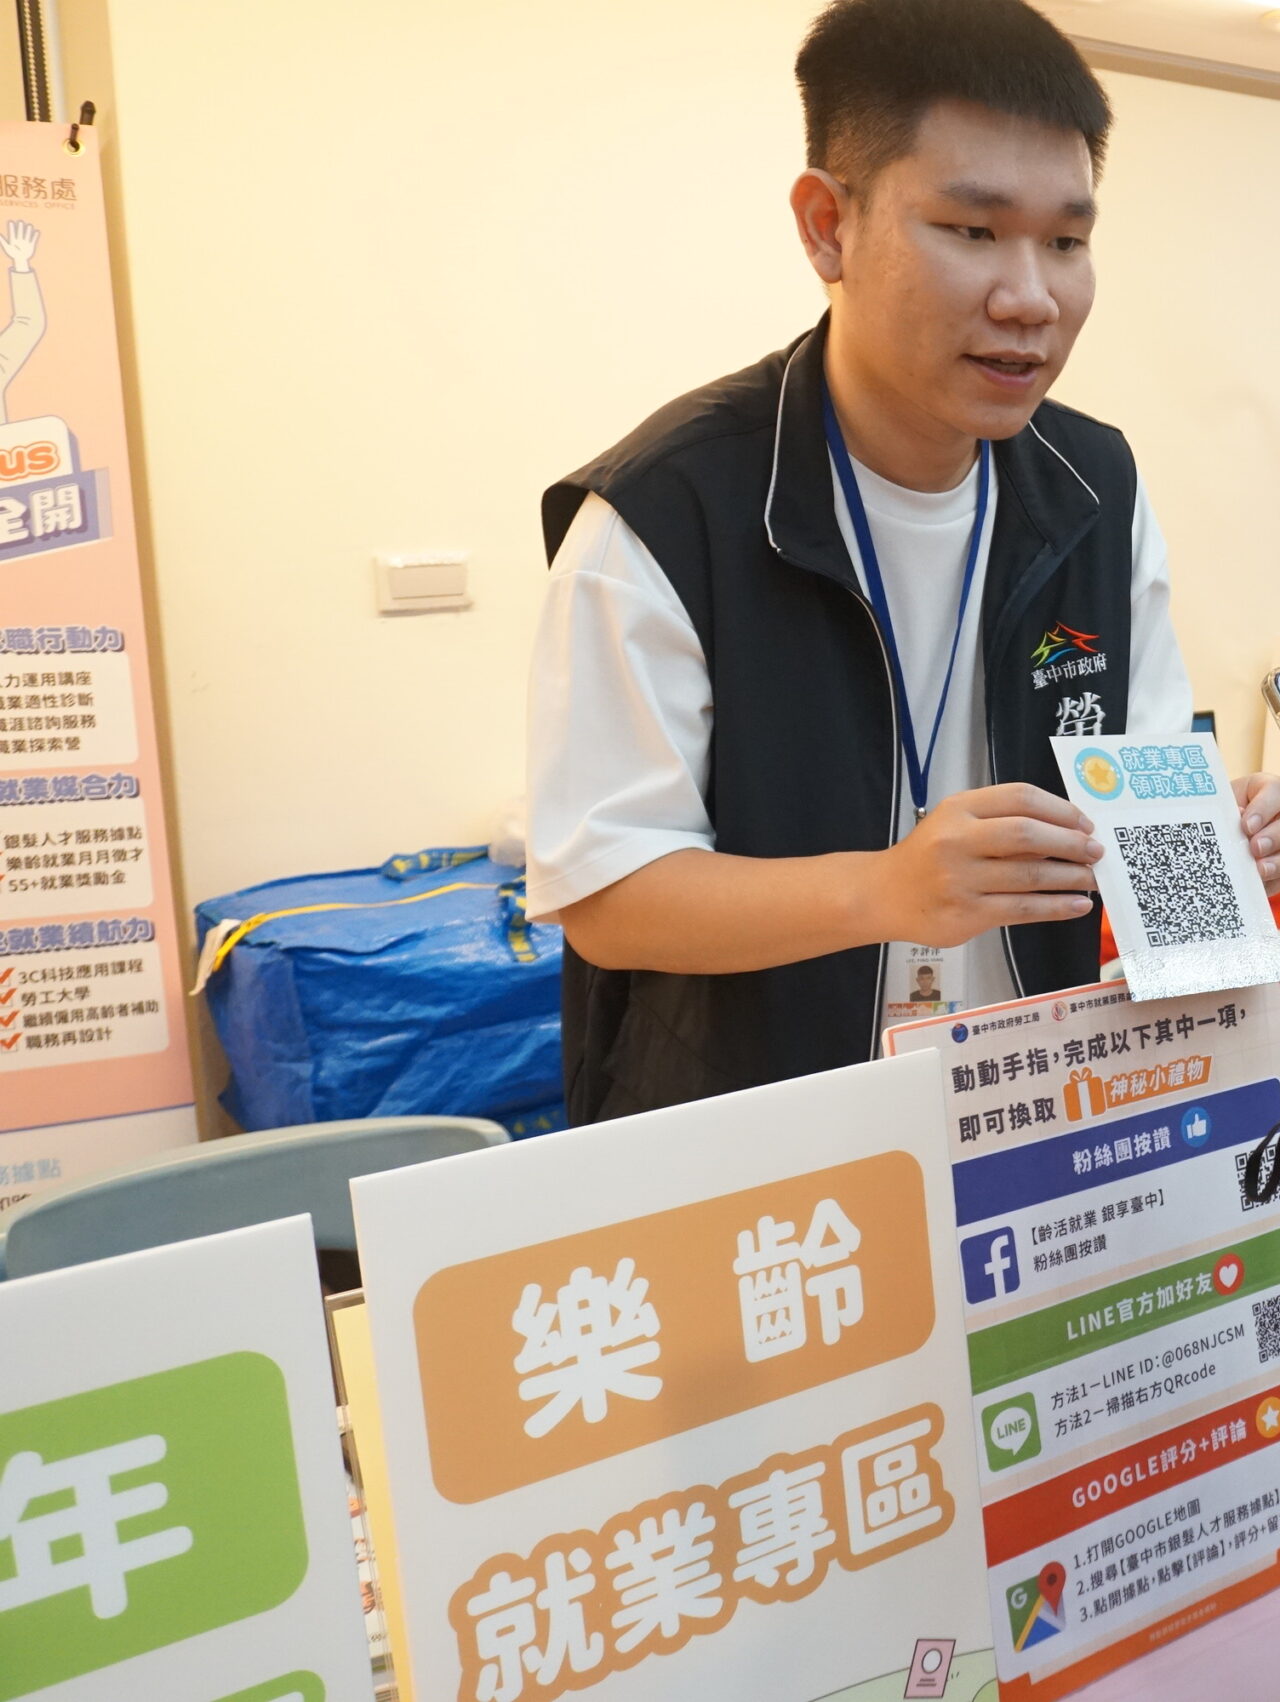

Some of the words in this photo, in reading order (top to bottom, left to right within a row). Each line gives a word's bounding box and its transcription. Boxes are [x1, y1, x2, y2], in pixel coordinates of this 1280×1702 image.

[0, 174, 77, 201] 服務處
[0, 625, 124, 655] 職行動力
[0, 671, 92, 688] 力運用講座
[1031, 653, 1107, 690] 臺中市政府
[1119, 745, 1208, 770] 就業專區
[1129, 772, 1216, 799] 領取集點
[4, 826, 143, 849] 銀髮人才服務據點
[6, 848, 144, 872] 樂齡就業月月徵才
[8, 869, 127, 892] 55+就業獎勵金
[0, 917, 154, 955] 就業續航力
[18, 958, 144, 984] 3C科技應用課程
[20, 986, 91, 1007] 勞工大學
[23, 1000, 159, 1028] 繼續僱用高齡者補助
[972, 1012, 1040, 1036] 臺中市政府勞工局
[25, 1027, 112, 1049] 職務再設計
[959, 1098, 1057, 1143] 即可換取
[1072, 1127, 1172, 1175] 粉絲團按讚
[1033, 1234, 1107, 1273] 粉絲團按讚
[1066, 1271, 1213, 1341] LINE官方加好友
[996, 1418, 1027, 1440] LINE
[1072, 1418, 1247, 1508] GOOGLE評分+評論
[0, 1434, 194, 1620] 年
[1073, 1498, 1201, 1570] 1.打開GOOGLE地圖
[458, 1410, 950, 1702] 就業專區
